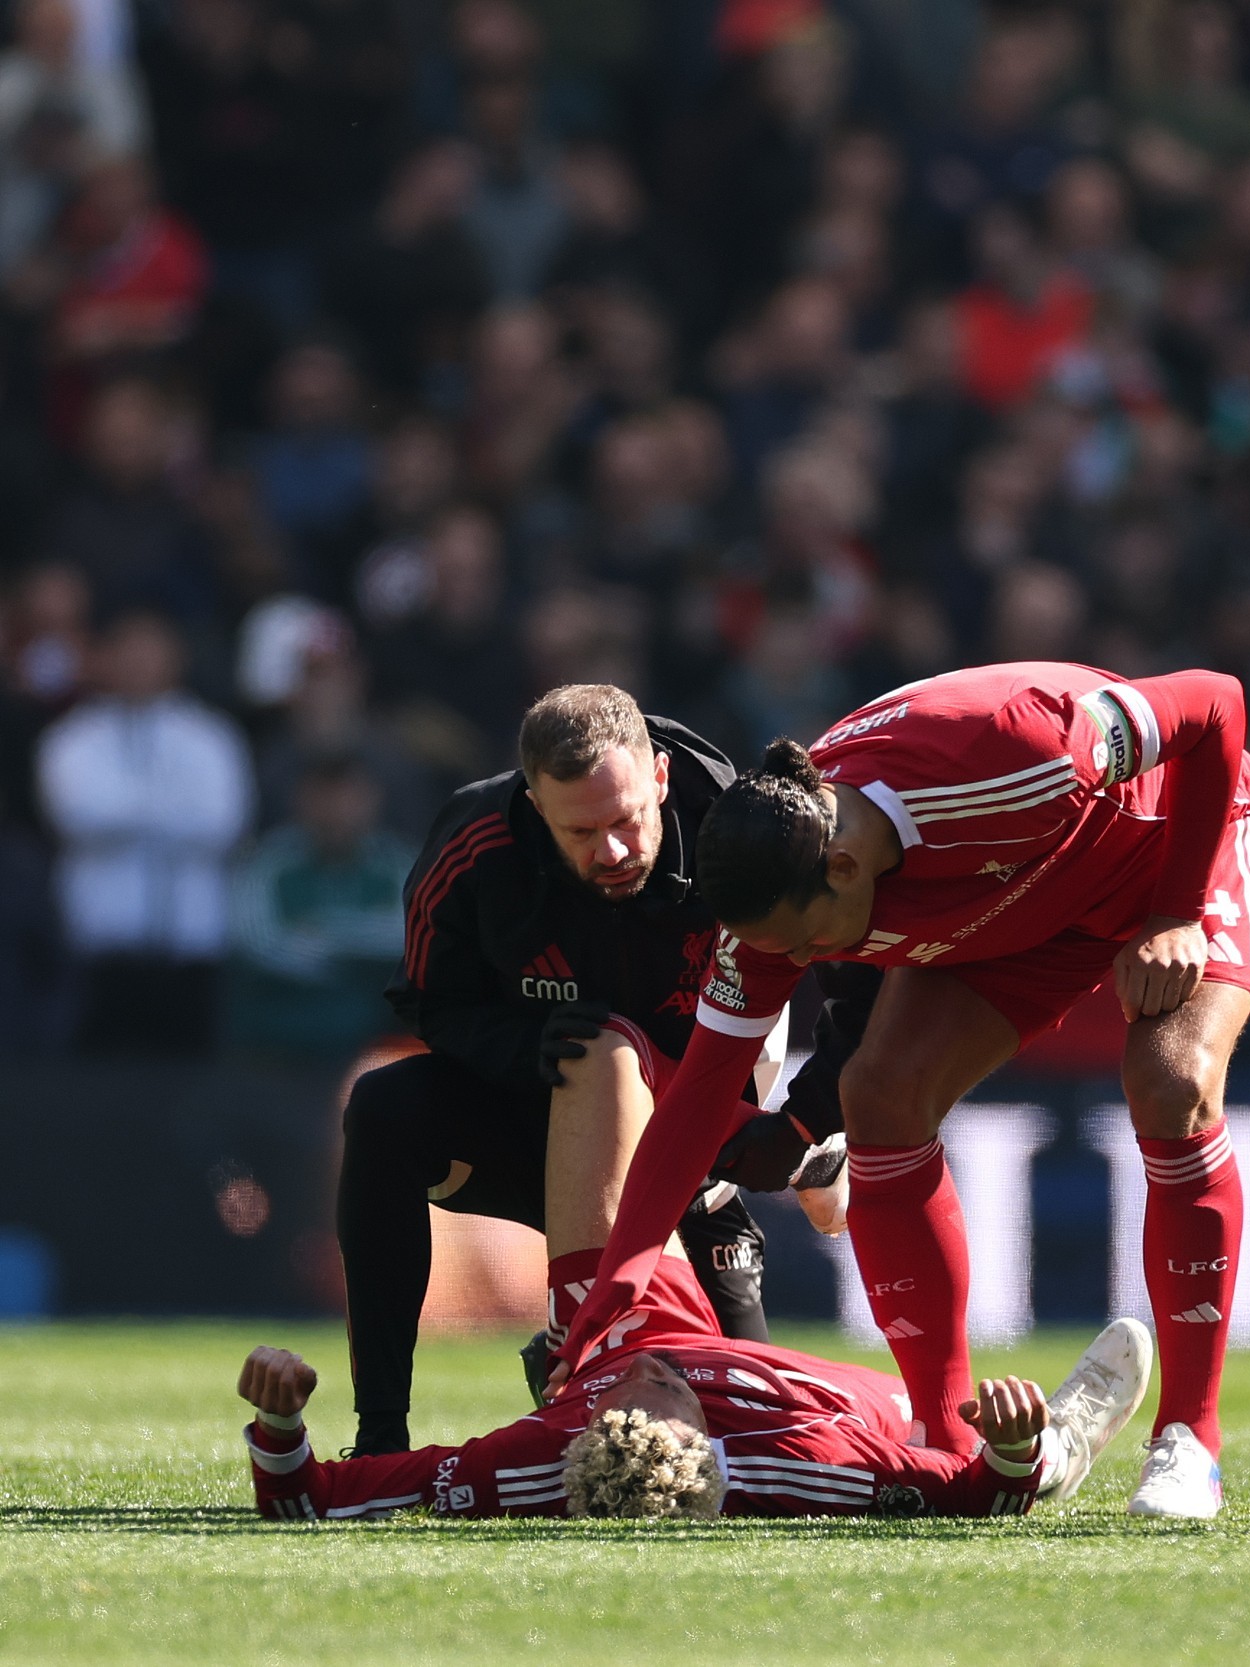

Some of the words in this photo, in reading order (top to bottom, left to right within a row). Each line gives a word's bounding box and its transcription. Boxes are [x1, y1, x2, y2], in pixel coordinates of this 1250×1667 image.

[712, 990, 745, 1011] racism
[715, 981, 744, 1000] room
[1168, 1256, 1229, 1276] LFC
